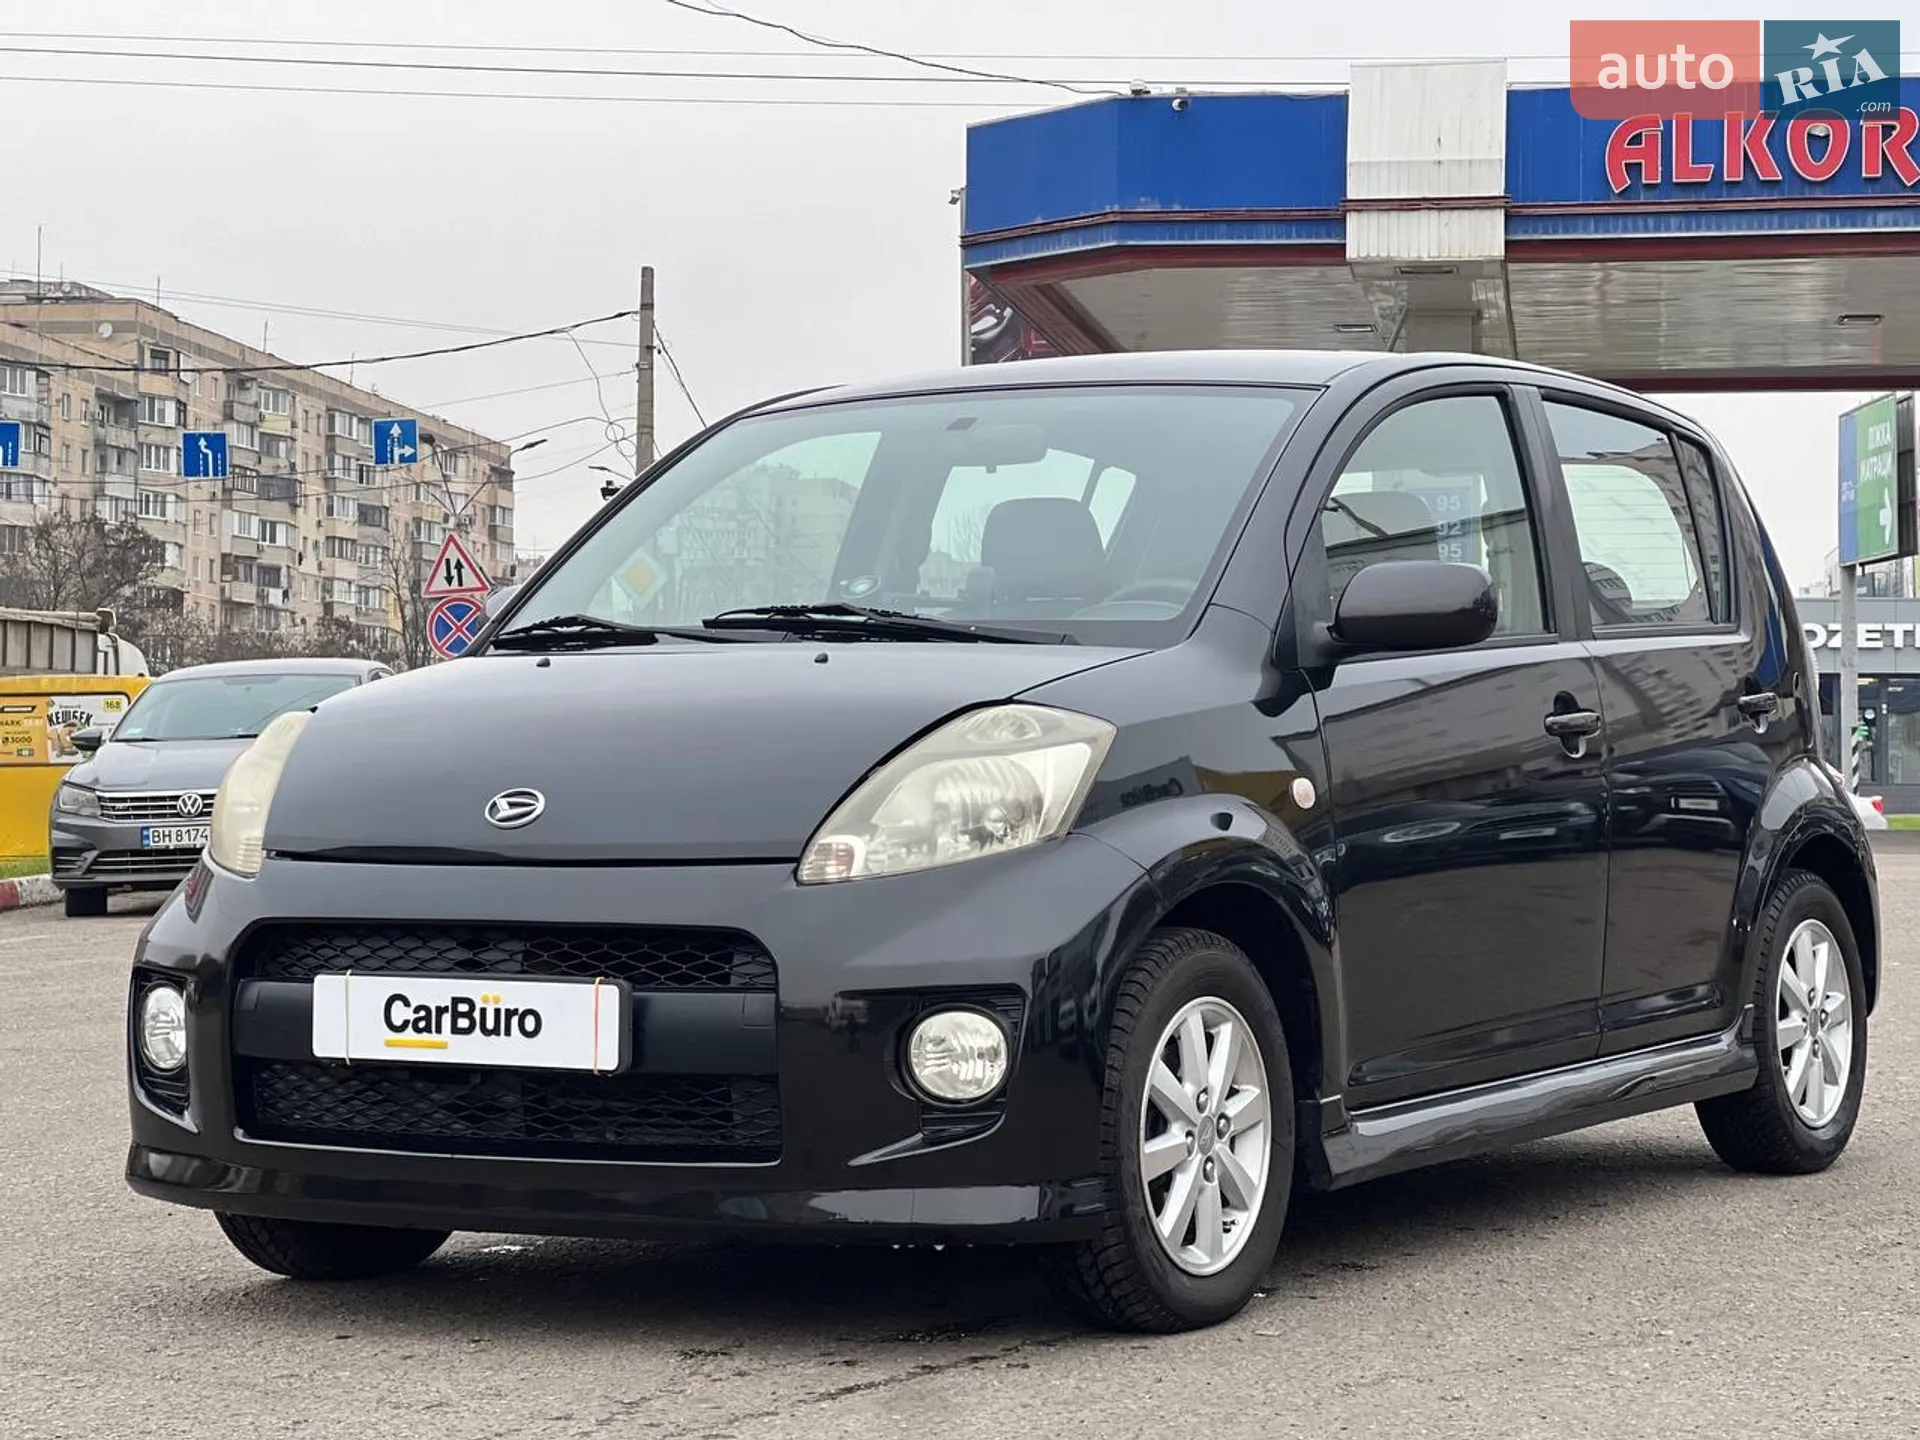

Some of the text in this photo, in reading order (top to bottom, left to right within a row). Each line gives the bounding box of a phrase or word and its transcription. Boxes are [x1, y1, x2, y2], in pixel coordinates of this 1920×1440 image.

[1605, 107, 1920, 194] ALKOR
[151, 828, 209, 844] BH 8174
[383, 993, 542, 1039] CarBüro
